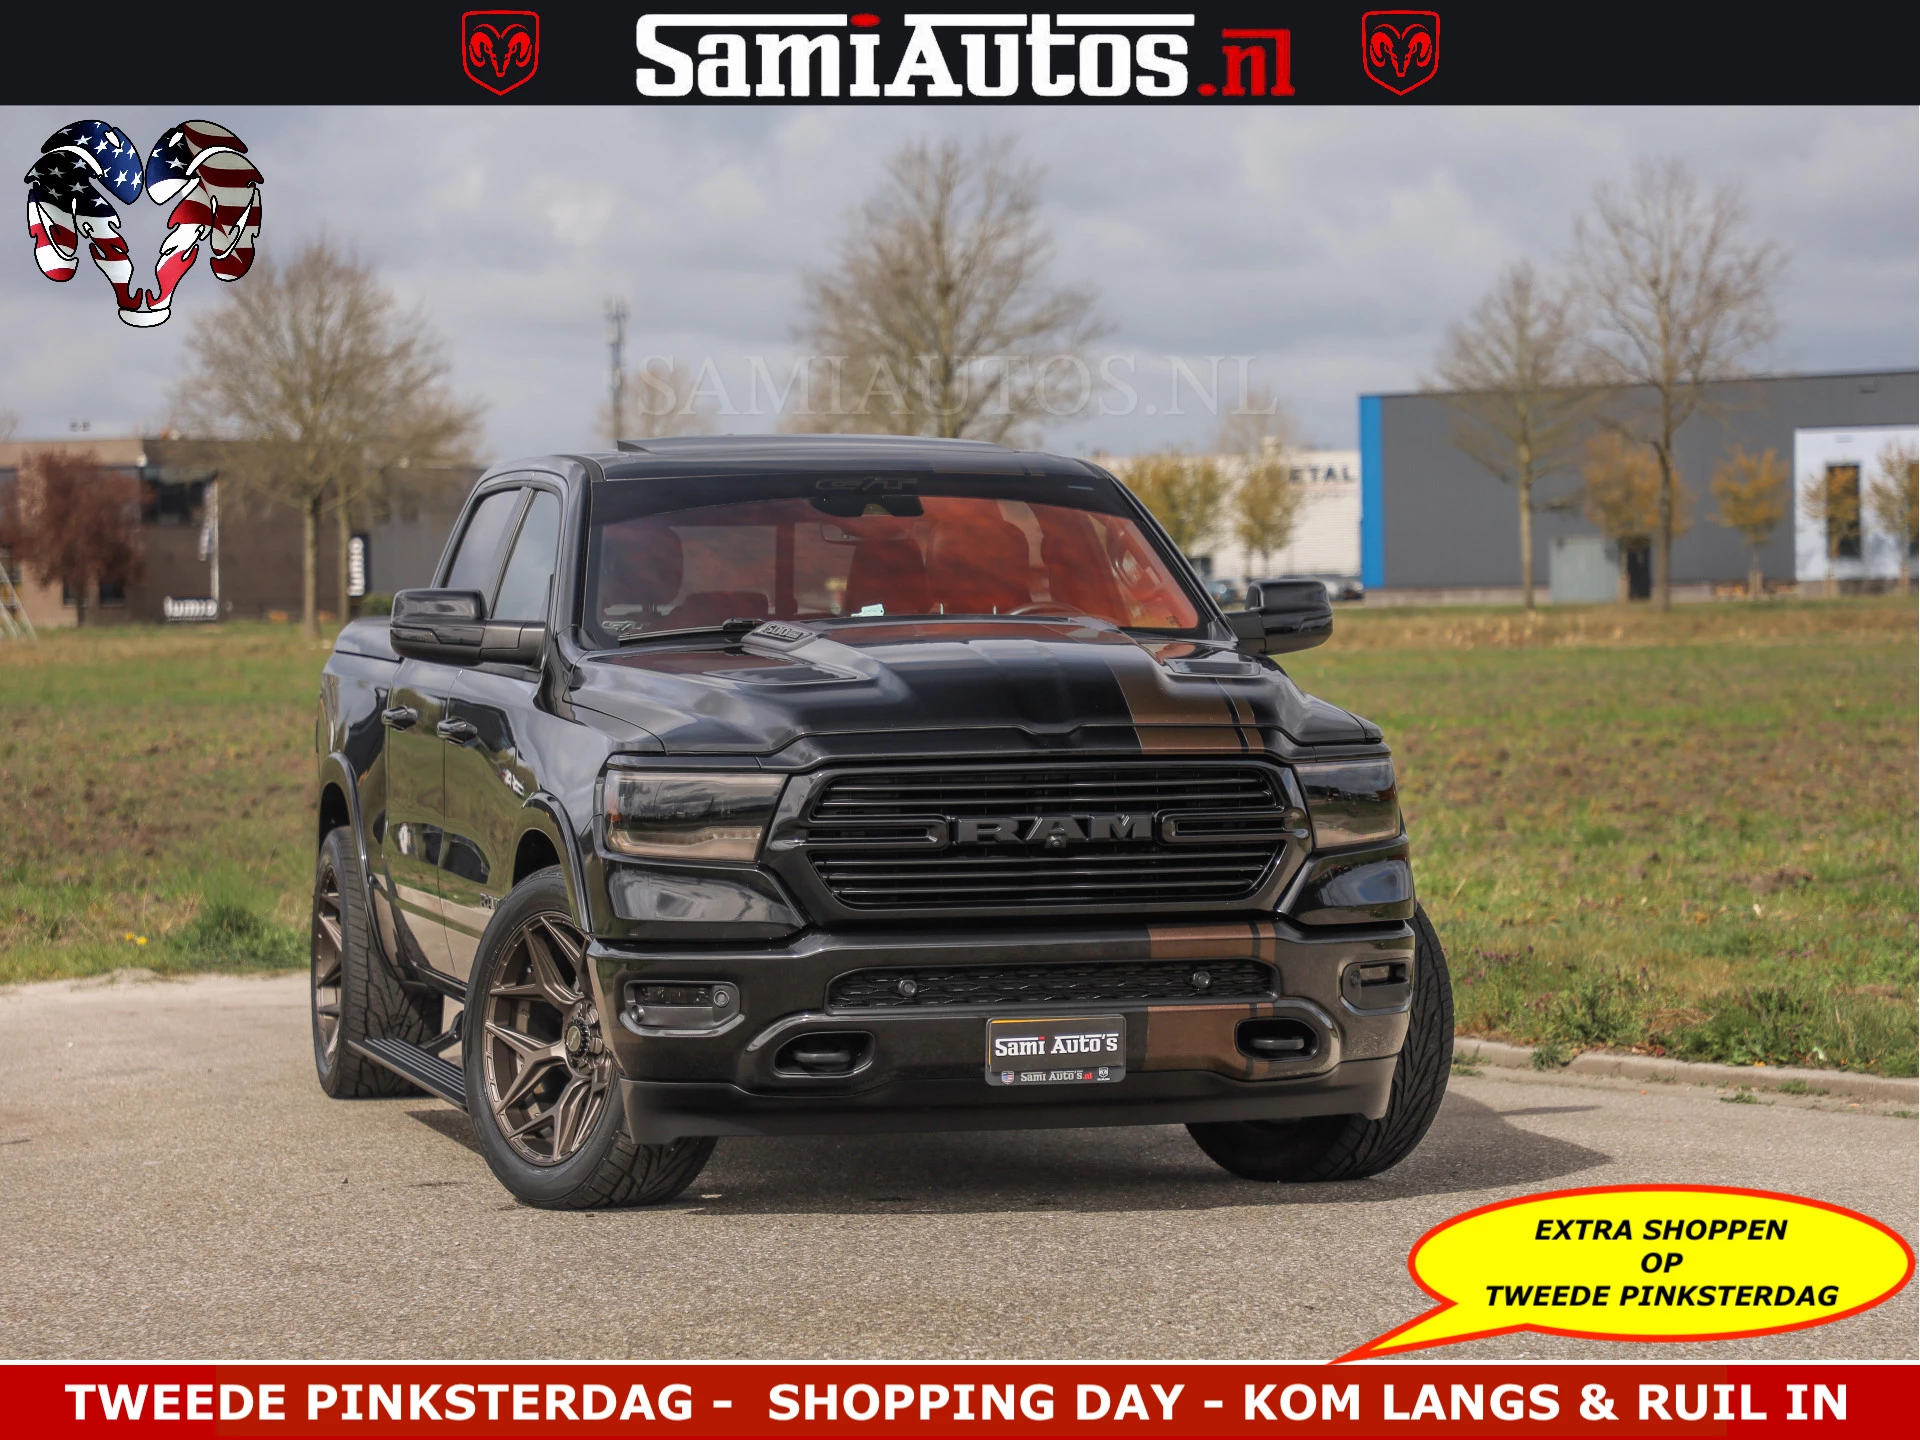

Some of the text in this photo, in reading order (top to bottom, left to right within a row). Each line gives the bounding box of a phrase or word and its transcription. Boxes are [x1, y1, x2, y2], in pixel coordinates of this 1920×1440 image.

[956, 814, 1154, 844] RAM
[995, 1033, 1119, 1057] Sami Auto's
[1020, 1071, 1047, 1082] Sami
